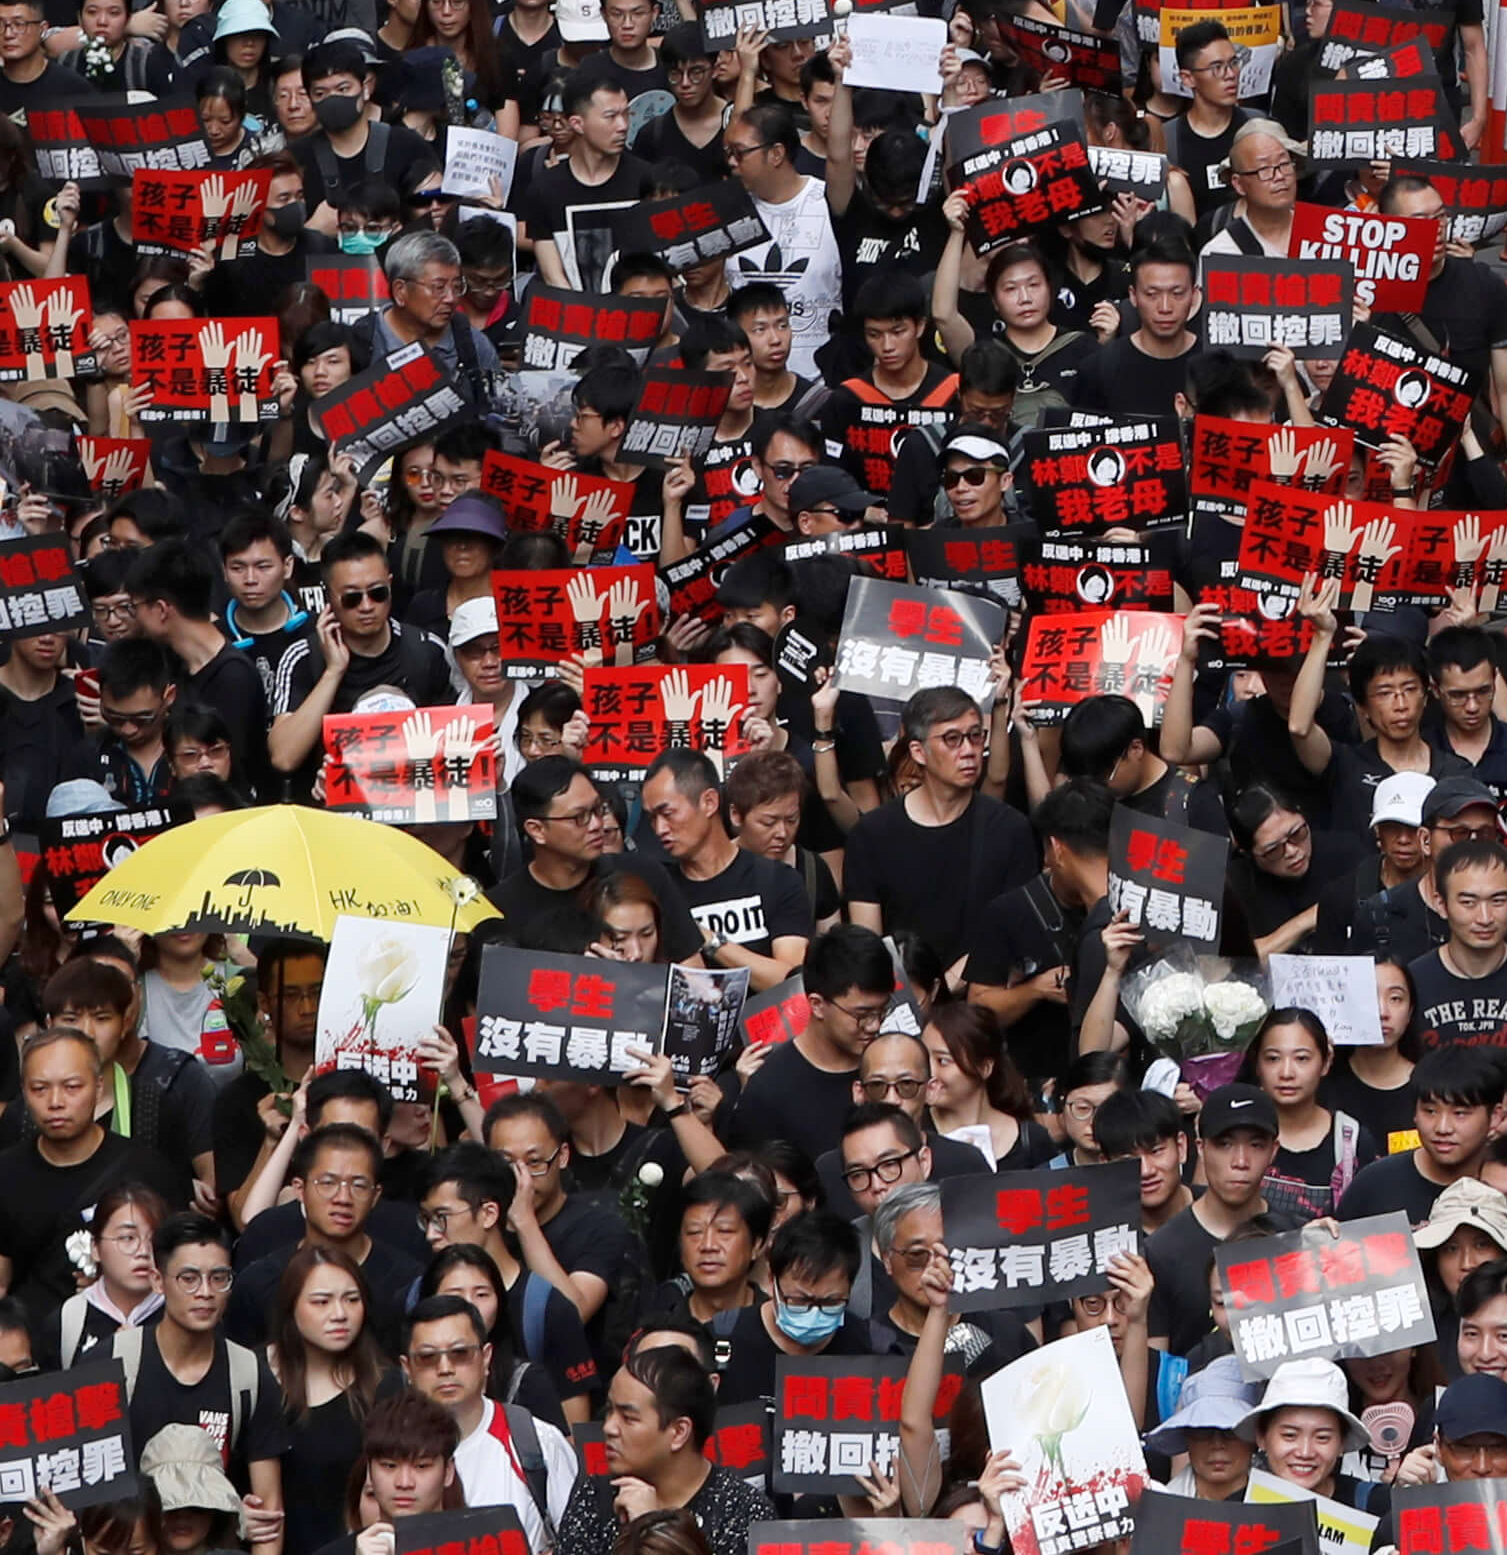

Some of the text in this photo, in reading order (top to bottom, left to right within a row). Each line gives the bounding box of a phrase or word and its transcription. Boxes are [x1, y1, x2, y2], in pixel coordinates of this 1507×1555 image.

[1312, 125, 1435, 159] 撤回控罪
[139, 181, 197, 211] 孩子
[1323, 213, 1407, 249] STOP
[1208, 311, 1343, 347] 撤回控罪
[136, 332, 197, 363] 孩子
[501, 584, 566, 617] 孩子
[589, 681, 658, 716] 孩子
[330, 887, 363, 912] HK
[527, 969, 616, 1019] 學生
[1424, 1005, 1465, 1034] THE
[478, 1015, 656, 1074] 沒有暴動
[995, 1184, 1092, 1235] 學生
[1237, 1283, 1427, 1366] 撤回控罪
[1030, 1484, 1130, 1539] 反送中
